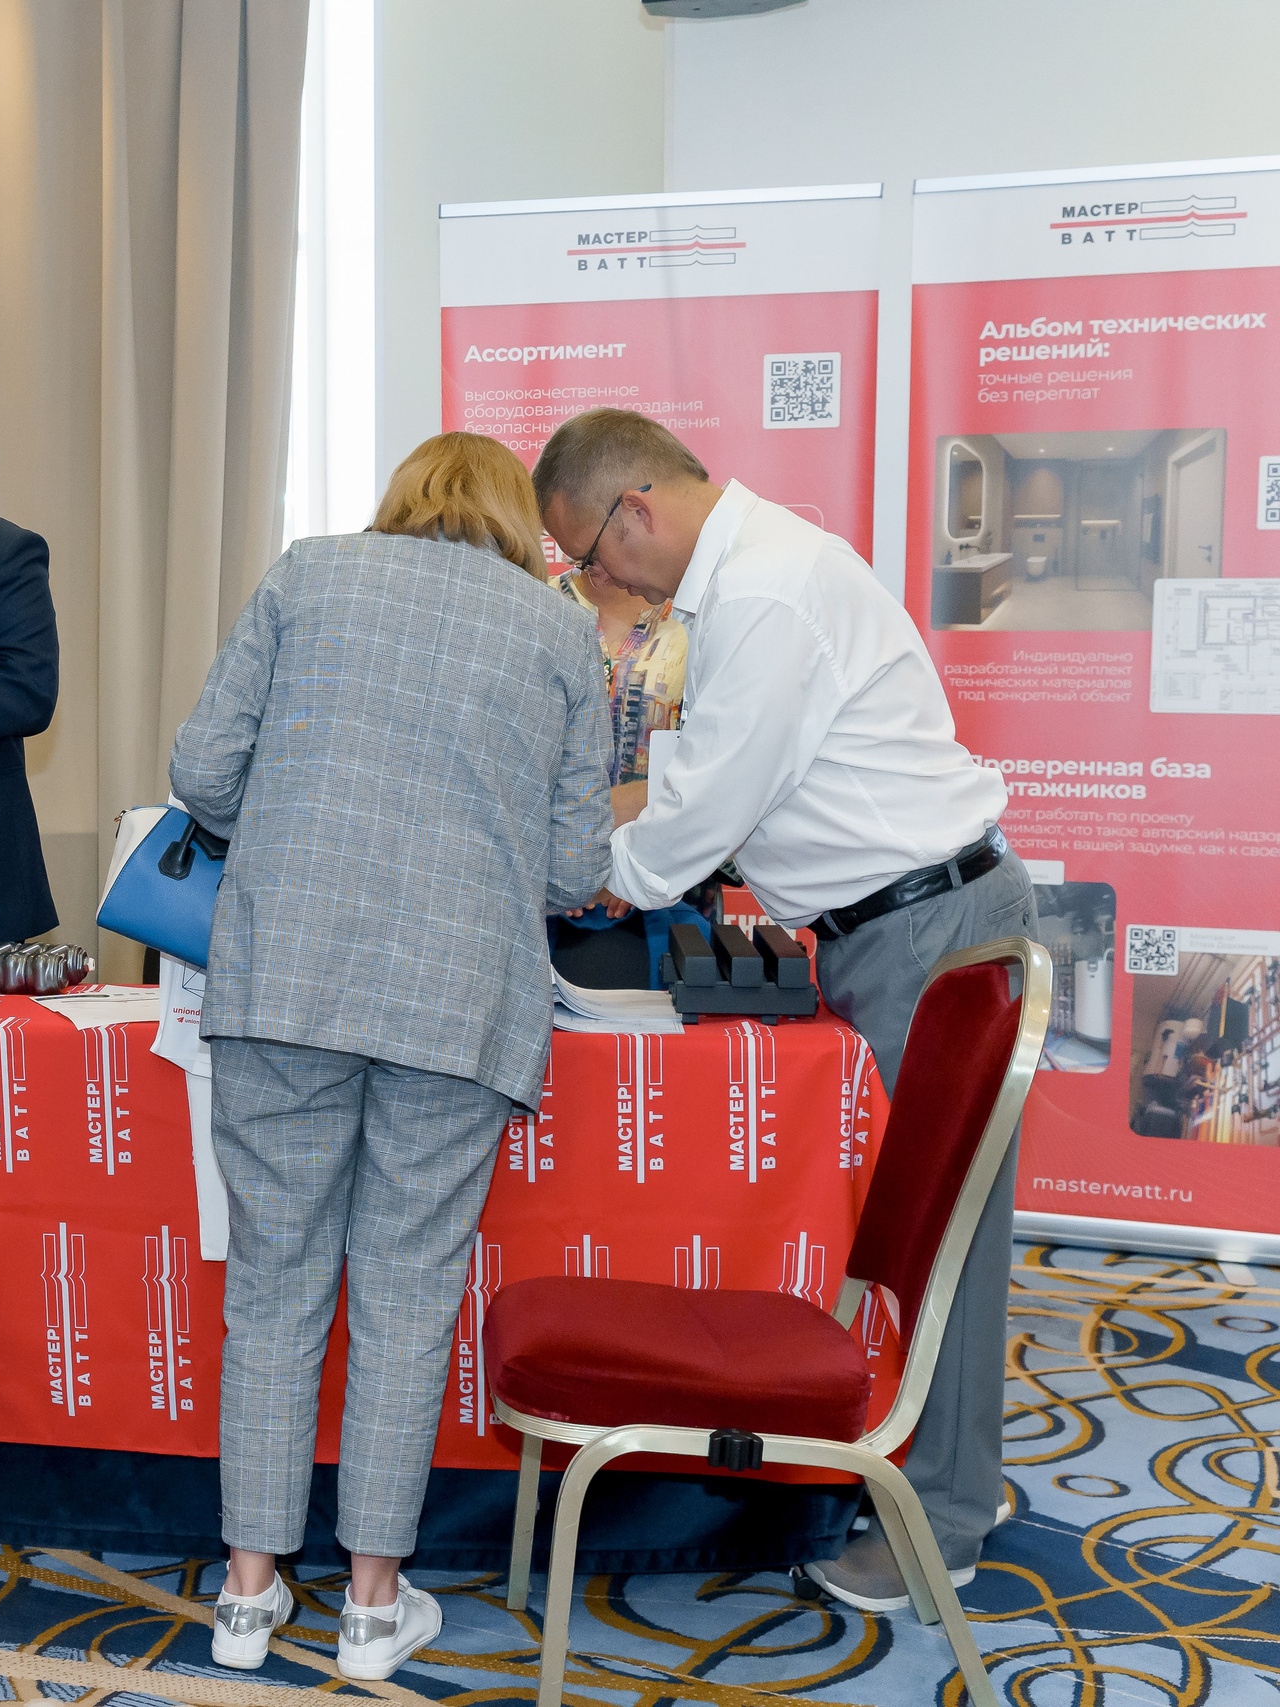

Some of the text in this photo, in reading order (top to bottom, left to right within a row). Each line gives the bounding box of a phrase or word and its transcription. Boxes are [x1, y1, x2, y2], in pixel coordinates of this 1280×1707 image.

[1061, 202, 1139, 219] МАСТЕР
[577, 230, 649, 246] МАСТЕР
[1061, 229, 1137, 246] ВАТТ
[577, 256, 647, 271] ВАТТ
[979, 312, 1267, 340] Альбом технических
[464, 340, 627, 365] Ассортимент
[979, 338, 1110, 366] решений:
[978, 369, 1133, 388] точные решения
[464, 385, 639, 402] высококачественное
[978, 386, 1100, 404] без переплат
[464, 403, 586, 420] оборудование
[625, 400, 703, 415] создания
[657, 416, 720, 430] пления
[1013, 650, 1133, 664] Индивидуально
[944, 662, 1133, 676] разработанный комплект
[949, 676, 1133, 690] технических материалов
[958, 689, 1132, 703] под конкретный объект
[1150, 757, 1211, 779] база
[1007, 780, 1147, 800] нтажников
[1002, 807, 1195, 828] еют работать по проекту
[1001, 823, 1065, 837] нимают,
[1067, 825, 1093, 837] что
[1095, 826, 1139, 838] такое
[1142, 827, 1226, 841] авторский
[1009, 838, 1058, 850] осятся
[1073, 840, 1125, 852] вашей
[1198, 844, 1226, 856] как
[1241, 845, 1280, 858] свое
[172, 1006, 200, 1016] uniond
[14, 1083, 30, 1161] ВАТТ
[86, 1083, 104, 1163] МАСТЕР
[115, 1084, 132, 1164] ВАТТ
[617, 1085, 633, 1171] МАСТЕР
[648, 1087, 664, 1170] ВАТТ
[729, 1085, 745, 1171] МАСТЕР
[761, 1086, 776, 1170] ВАТТ
[839, 1082, 852, 1169] МАСТЕР
[853, 1085, 870, 1167] ВАТТ
[508, 1116, 524, 1170] МАСТ
[1032, 1176, 1193, 1203] masterwatt.ru
[47, 1328, 64, 1405] МАСТЕР
[75, 1331, 92, 1406] ВАТТ
[149, 1332, 166, 1409] МАСТЕР
[178, 1334, 194, 1411] ВАТТ
[458, 1342, 473, 1424] МАСТЕР
